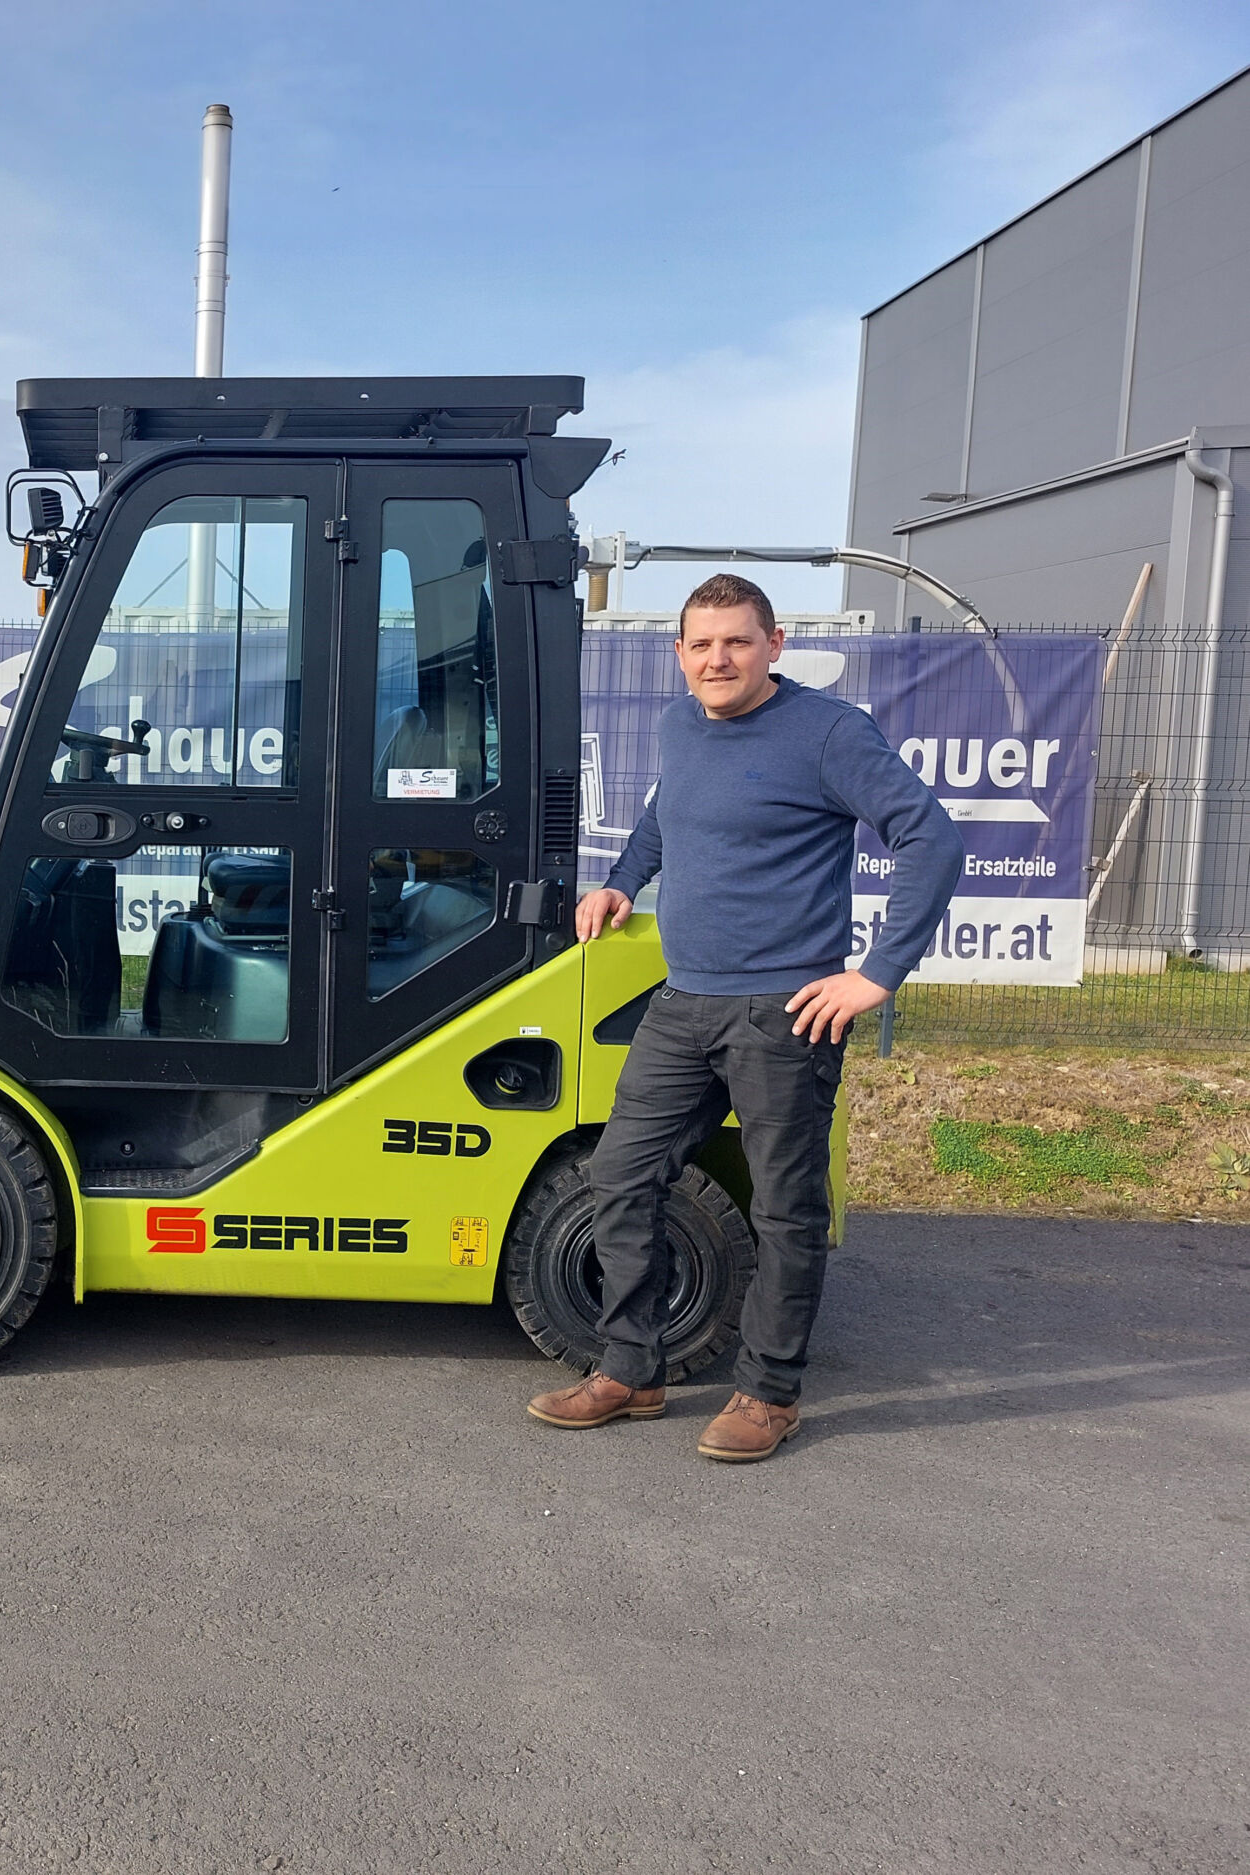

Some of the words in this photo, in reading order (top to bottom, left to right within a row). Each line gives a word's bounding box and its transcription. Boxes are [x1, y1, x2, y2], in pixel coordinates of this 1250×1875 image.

[964, 854, 1057, 878] Ersatzteile
[382, 1118, 492, 1158] 35D
[210, 1213, 412, 1254] SERIES
